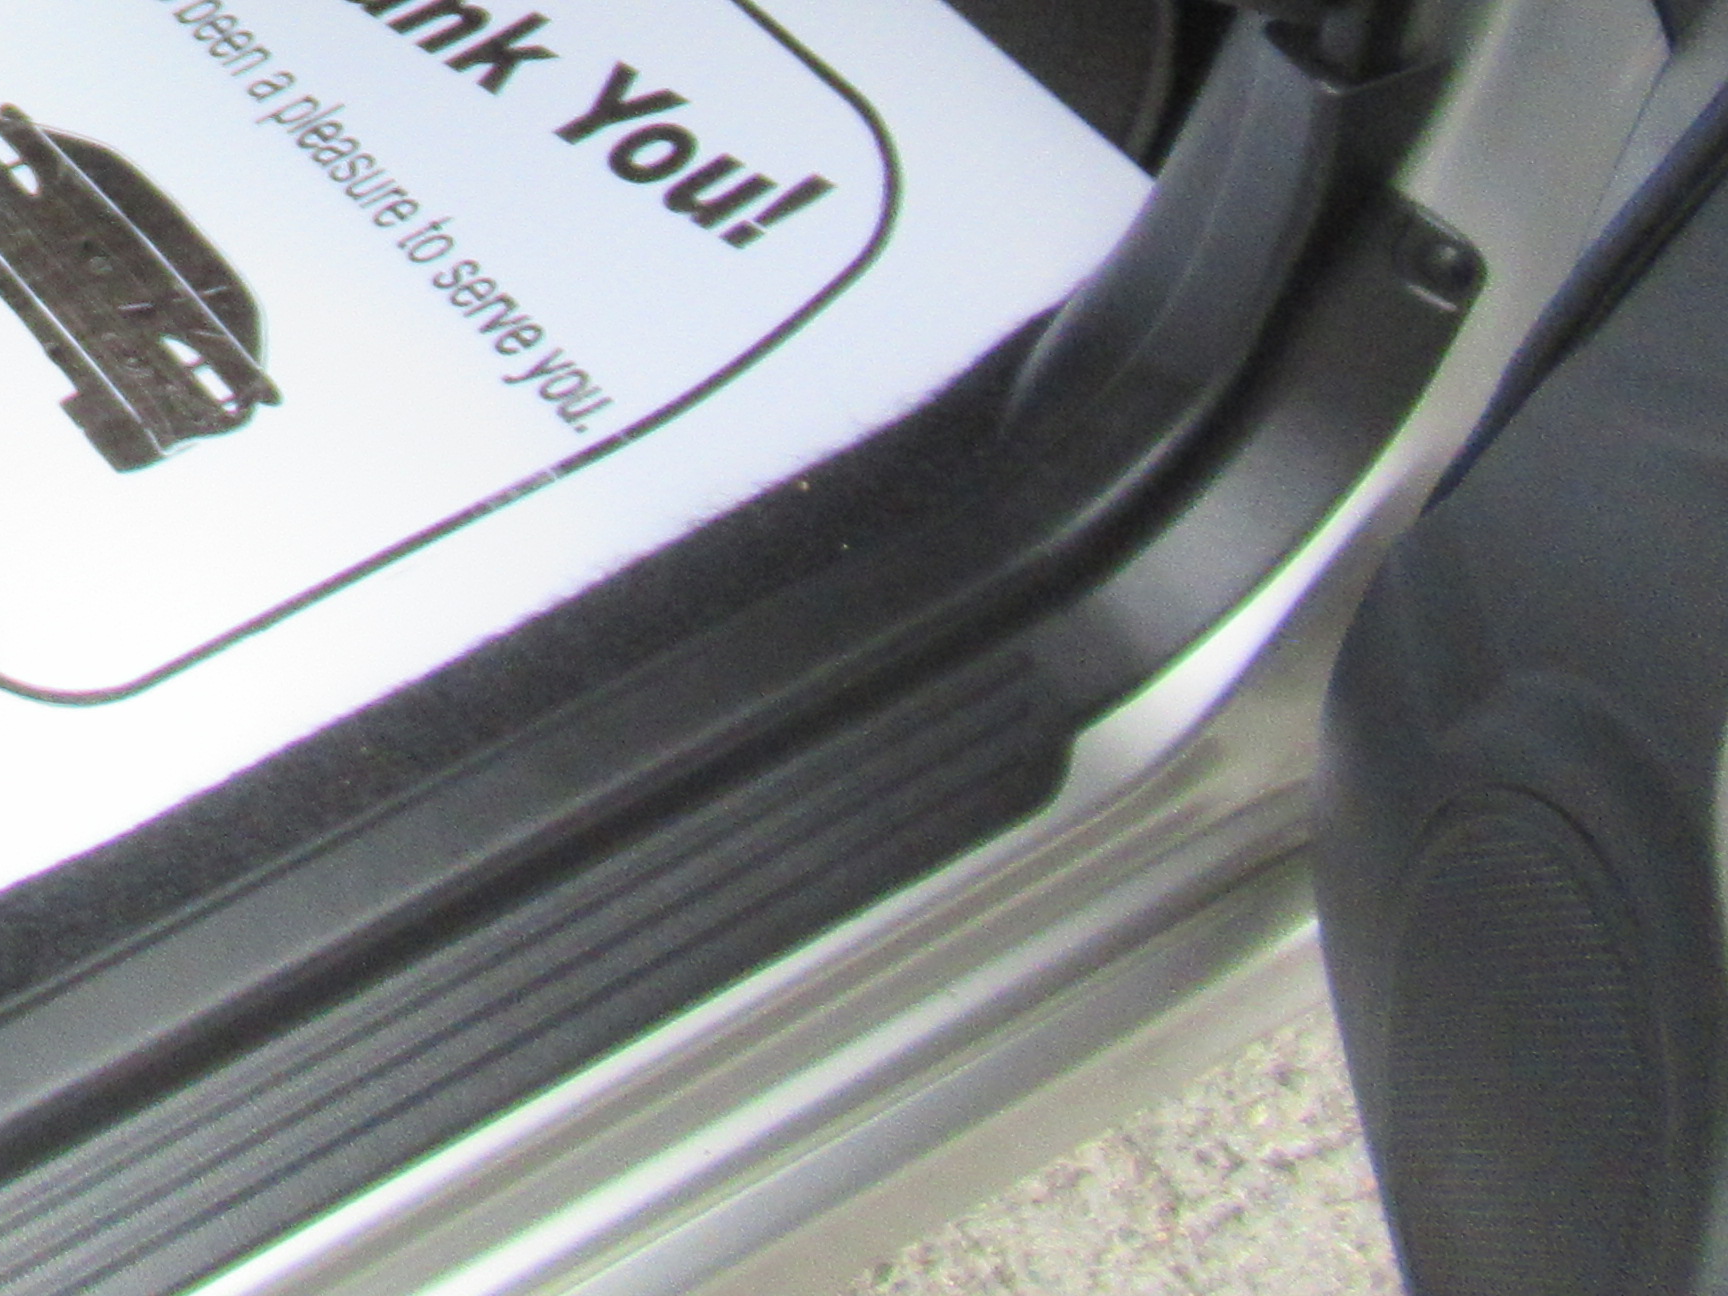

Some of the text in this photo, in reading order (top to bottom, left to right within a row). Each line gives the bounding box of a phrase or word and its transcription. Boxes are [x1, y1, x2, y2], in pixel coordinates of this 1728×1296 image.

[247, 70, 296, 102] a
[255, 95, 420, 227] pleasure
[554, 62, 833, 249] You!
[397, 216, 454, 262] to
[432, 259, 544, 355] serve
[502, 347, 614, 433] you.
